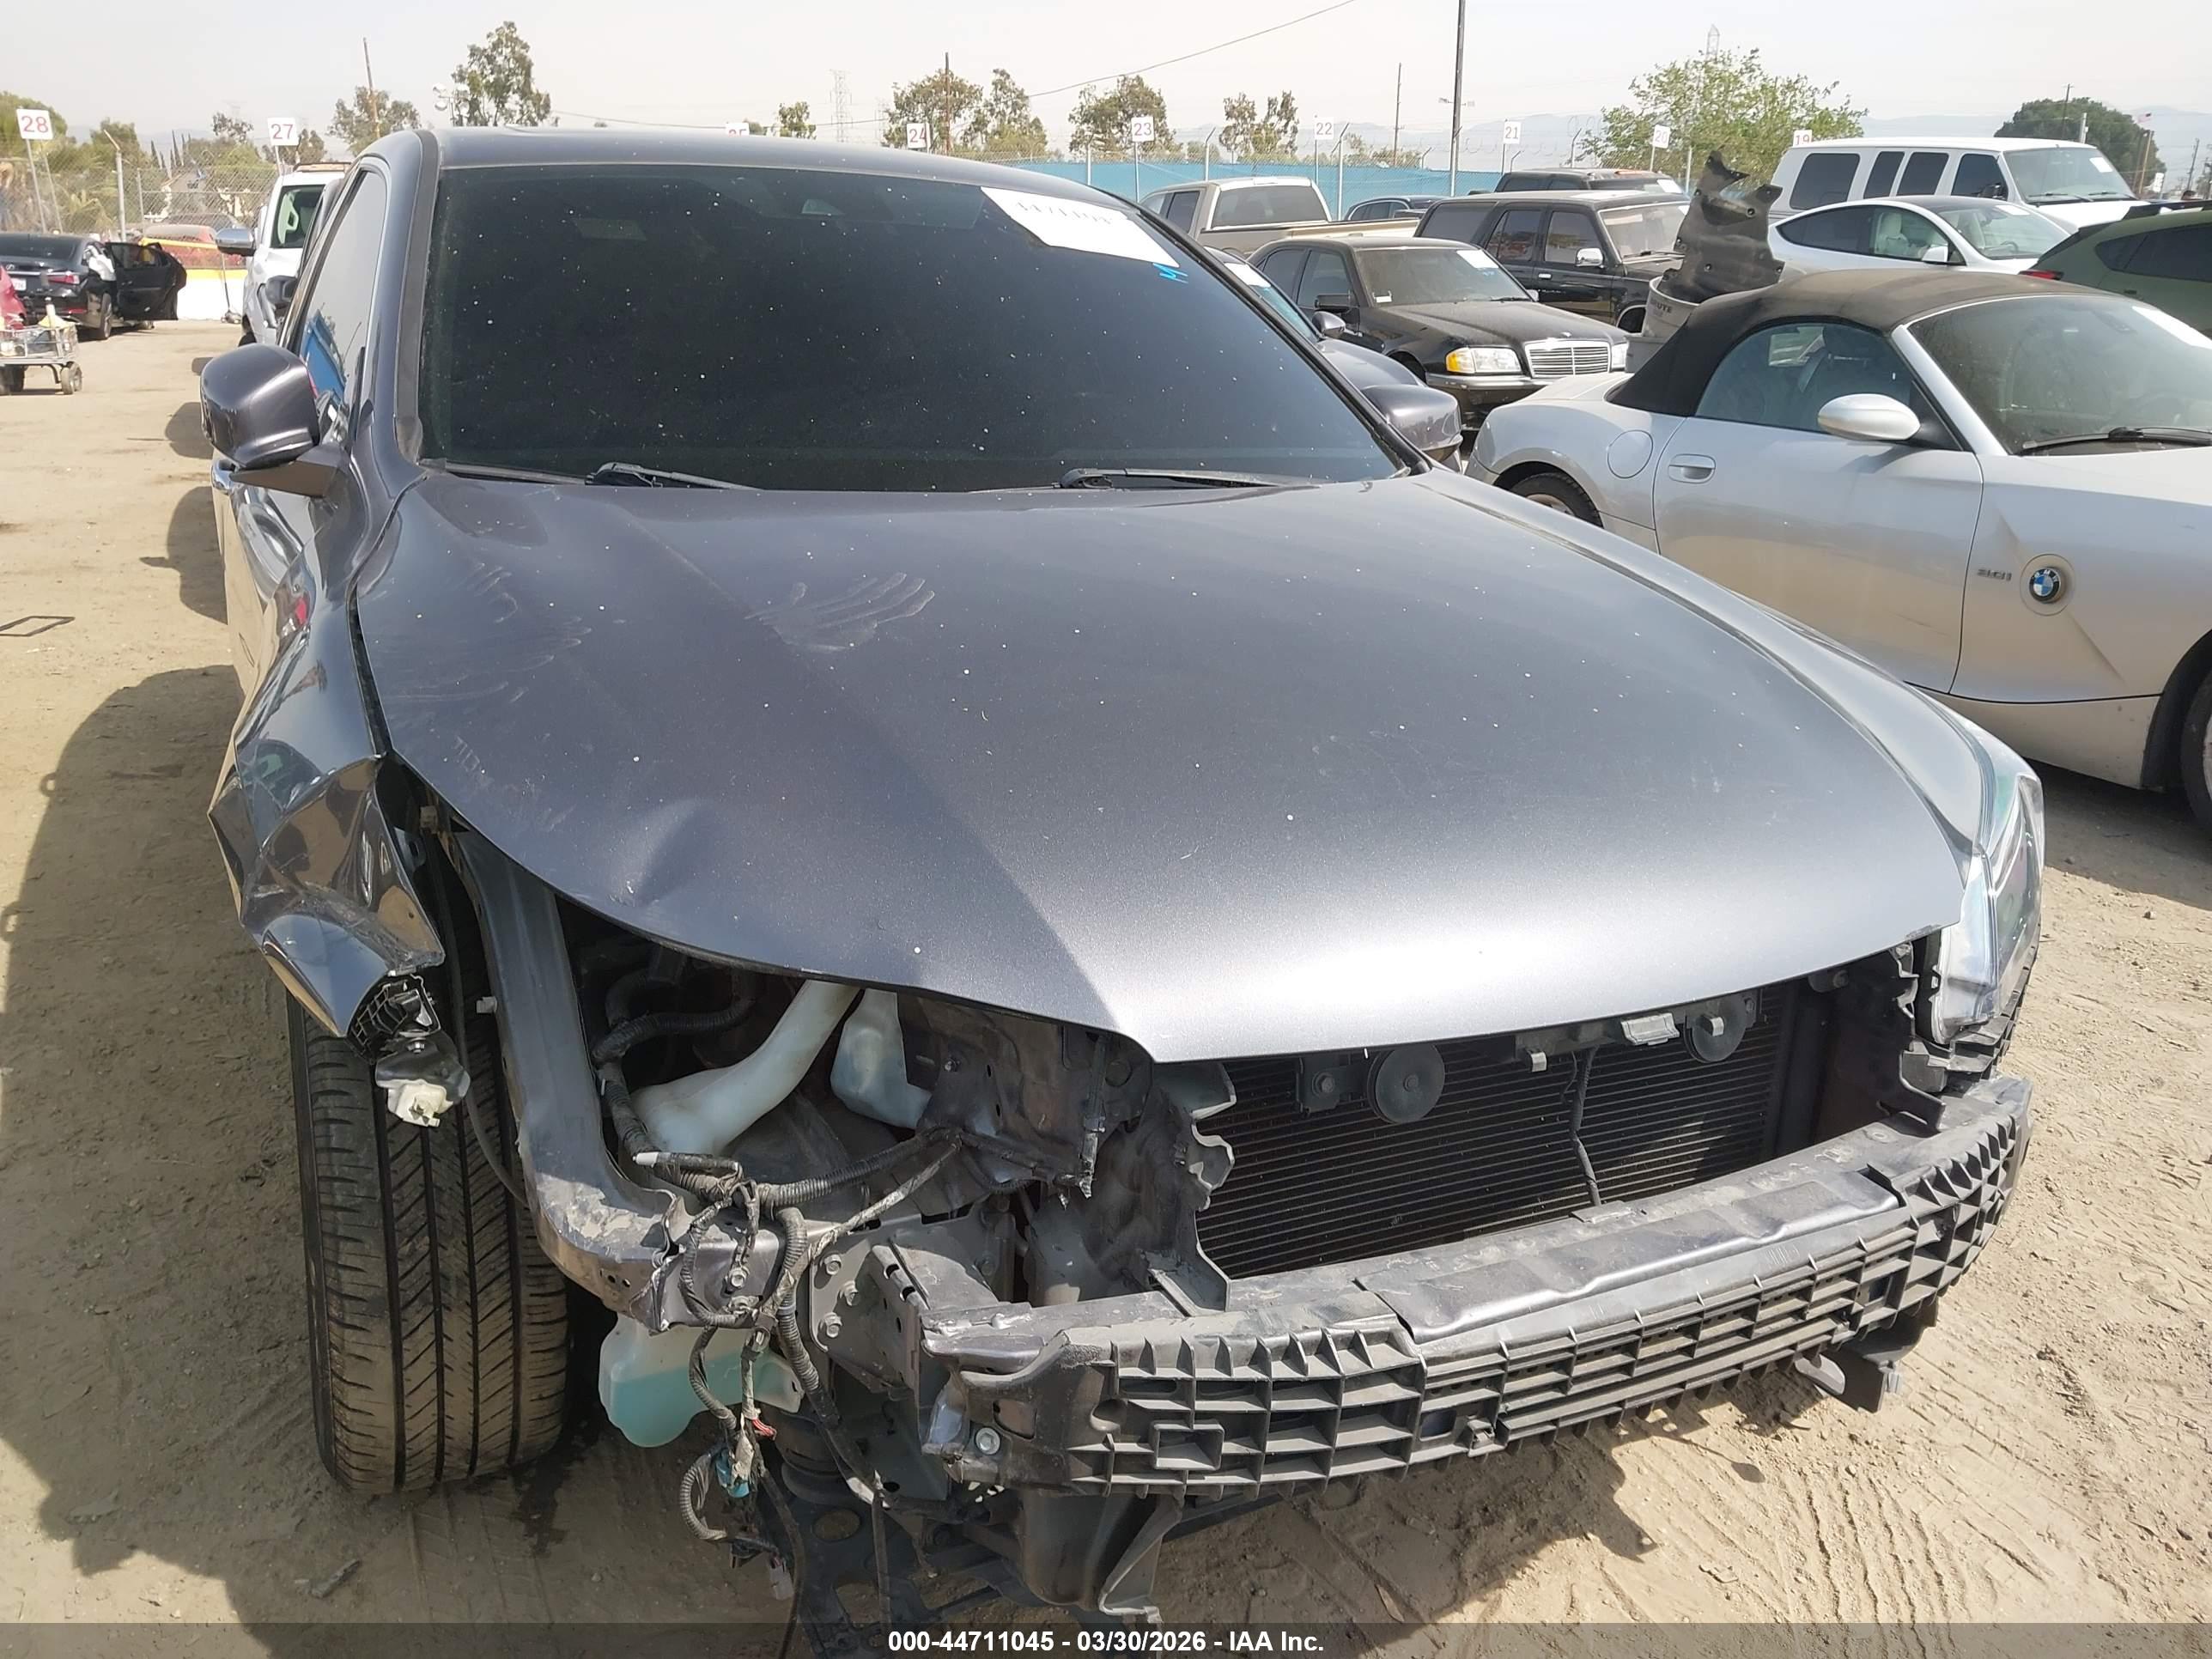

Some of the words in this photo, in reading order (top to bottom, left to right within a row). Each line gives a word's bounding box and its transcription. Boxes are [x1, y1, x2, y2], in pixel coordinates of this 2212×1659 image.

[21, 115, 49, 133] 28
[1133, 123, 1152, 136] 23
[1316, 122, 1333, 136] 22
[270, 124, 294, 139] 27
[909, 128, 927, 143] 24
[1504, 126, 1519, 139] 21
[1655, 130, 1668, 143] 20
[1796, 134, 1810, 145] 19
